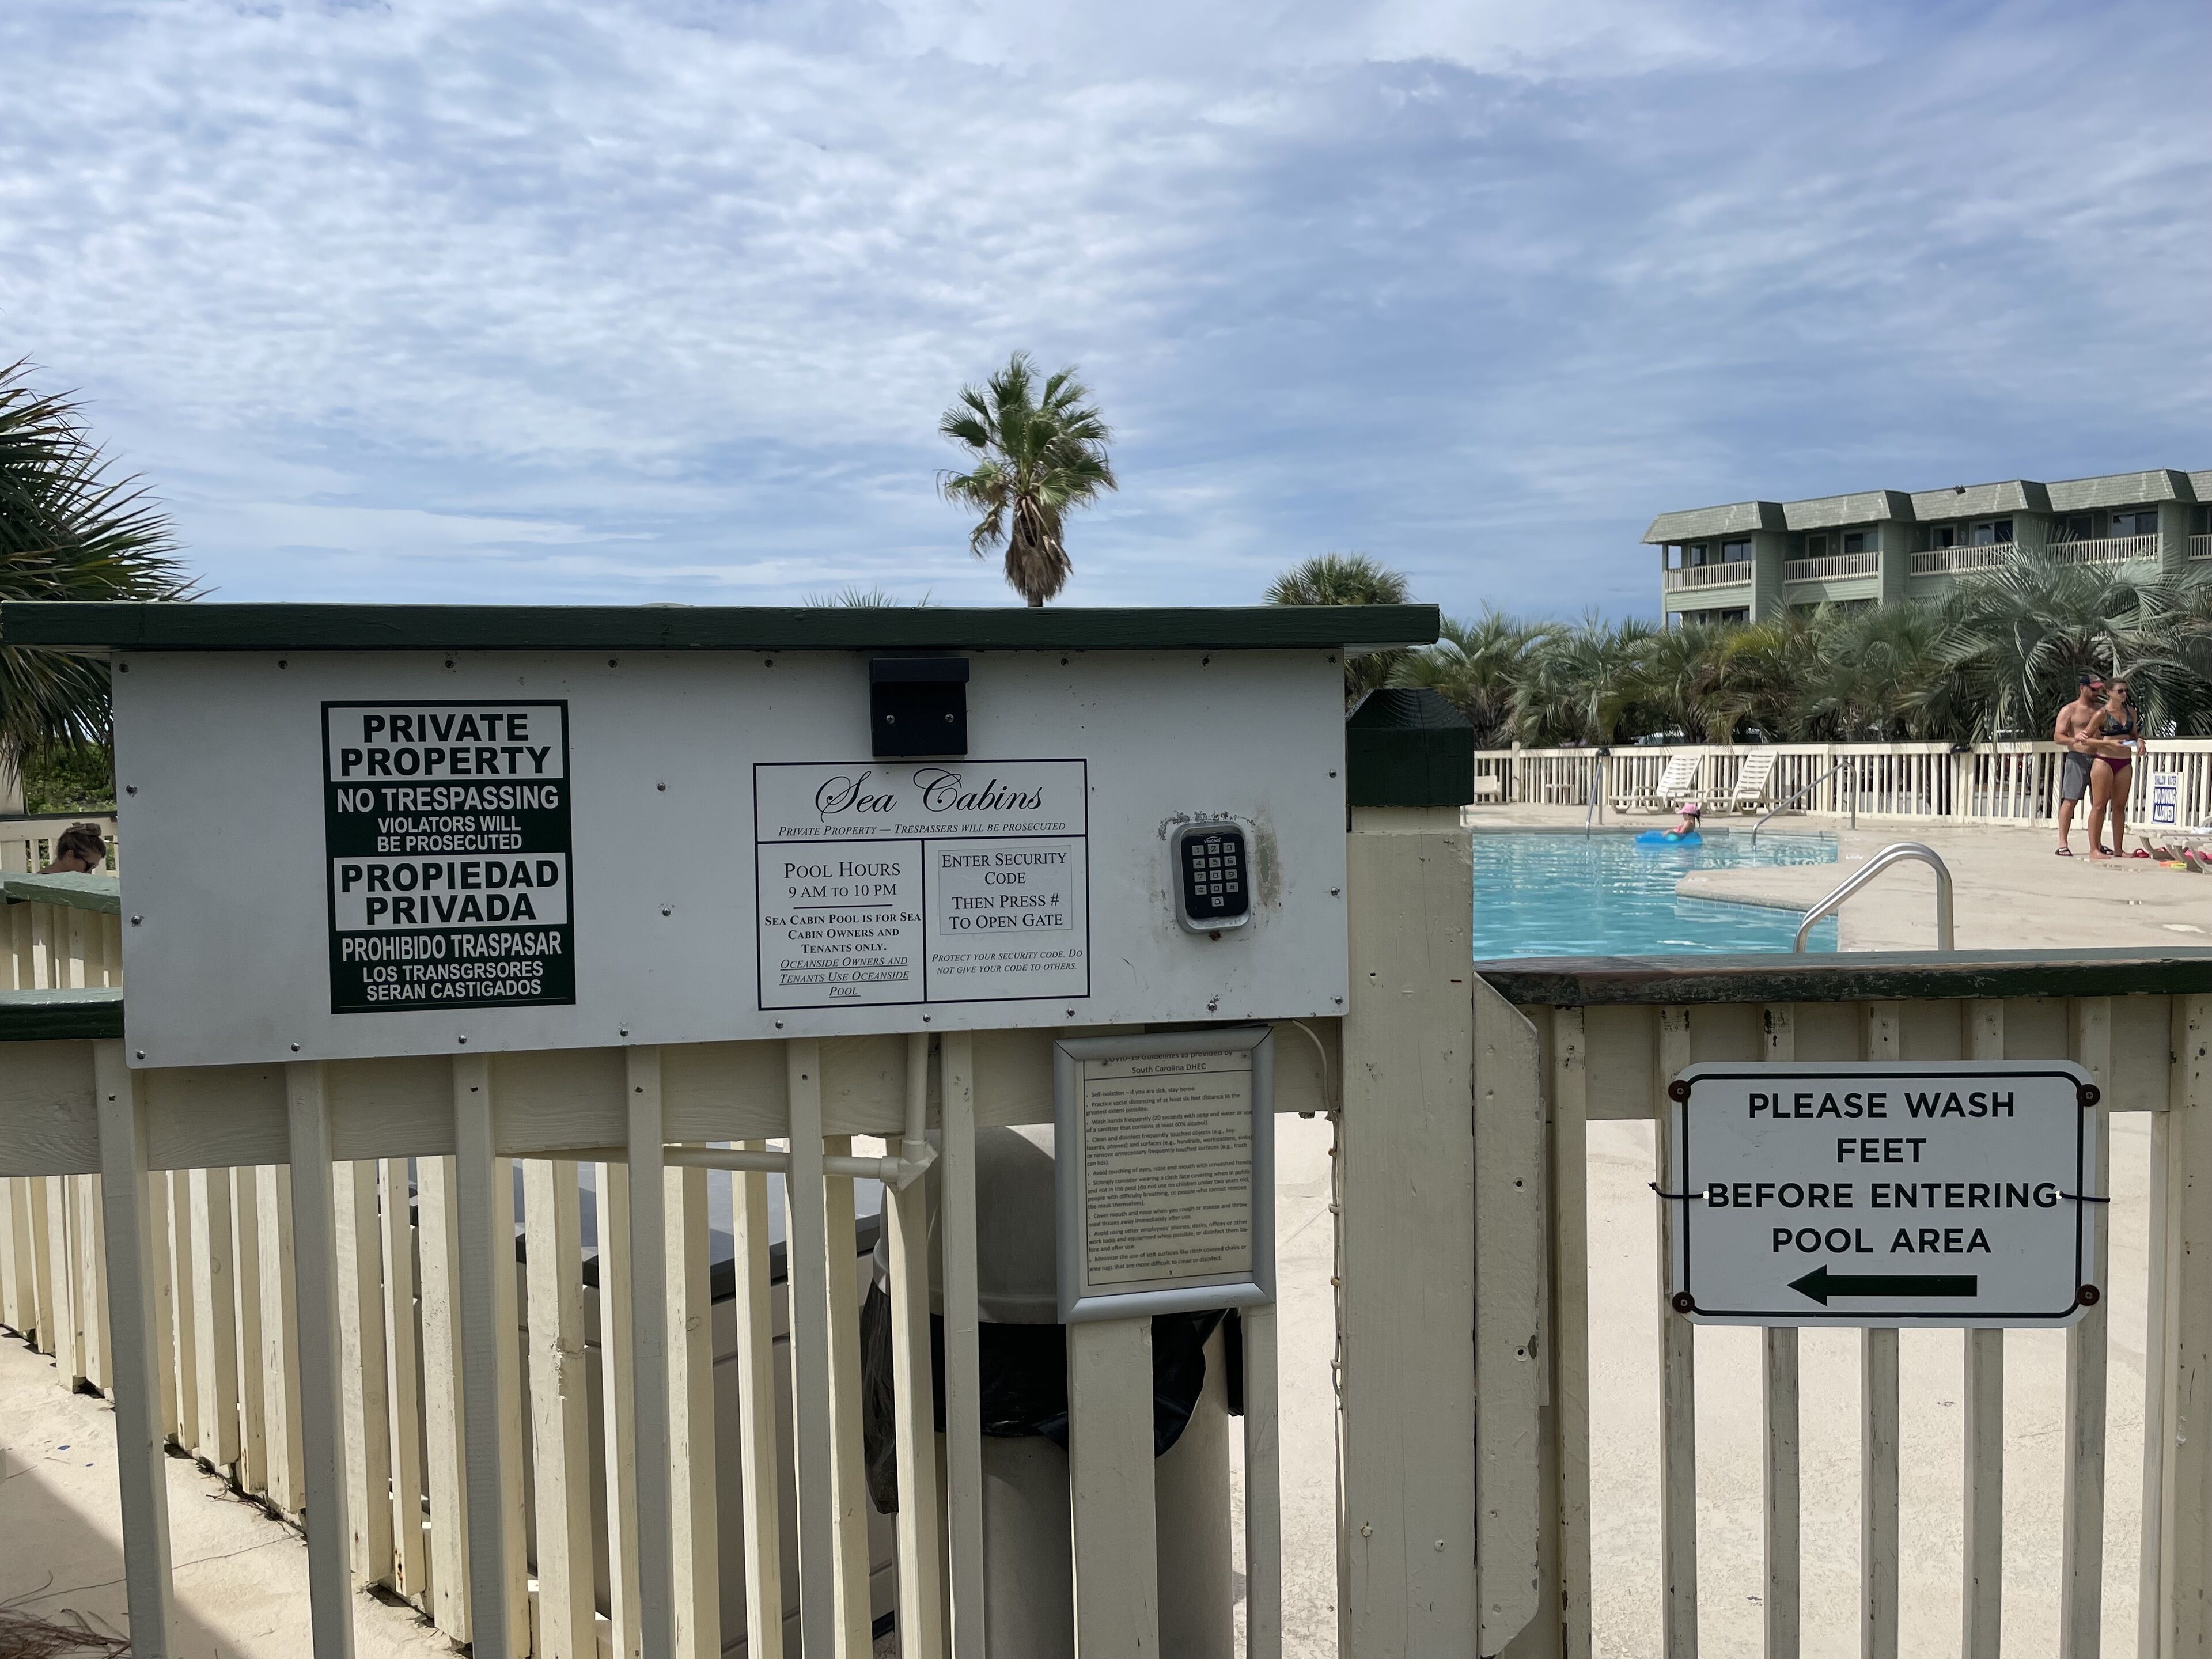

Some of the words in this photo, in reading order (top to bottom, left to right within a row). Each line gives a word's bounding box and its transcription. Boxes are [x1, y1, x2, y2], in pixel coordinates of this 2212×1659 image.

[363, 714, 528, 743] PRIVATE
[341, 747, 551, 776] PROPERTY
[338, 789, 374, 812] NO
[381, 786, 558, 811] TRESPASSING
[815, 771, 897, 823] Sea
[913, 768, 1042, 812] Cabins
[2154, 788, 2160, 804] NO
[2161, 789, 2176, 804] DIVING
[2154, 805, 2174, 821] ALLOWED
[378, 816, 475, 833] VIOLATORS
[480, 816, 521, 831] WILL
[378, 836, 400, 851] BE
[406, 834, 522, 851] PROSECUTED
[942, 855, 991, 867] ENTER
[996, 853, 1067, 866] SECURITY
[342, 861, 558, 892] PROPIEDAD
[785, 863, 832, 878] POOL
[839, 862, 900, 877] HOURS
[985, 872, 1025, 884] CODE
[789, 887, 796, 898] 9
[801, 886, 826, 897] AM
[832, 888, 848, 896] TO
[855, 885, 869, 896] 10
[874, 884, 896, 896] PM
[366, 893, 536, 925] PRIVADA
[952, 897, 994, 909] THEN
[999, 895, 1045, 908] PRESS
[1051, 893, 1059, 906] #
[765, 916, 786, 925] SEA
[790, 916, 824, 925] CABIN
[830, 915, 859, 923] POOL
[900, 912, 921, 921] SEA
[949, 916, 970, 929] TO
[976, 915, 1017, 928] OPEN
[1022, 914, 1063, 926] GATE
[788, 930, 823, 939] CABIN
[827, 929, 873, 938] OWNERS
[343, 935, 445, 961] PROHIBIDO
[451, 931, 562, 957] TRASPASAR
[801, 944, 851, 953] TENANTS
[780, 959, 838, 969] OCEANSIDE
[842, 957, 884, 967] OWNERS
[888, 956, 908, 965] AND
[363, 966, 397, 982] LOS
[403, 961, 543, 980] TRANSGRSORES
[779, 973, 824, 984] TENANTS
[828, 972, 849, 982] USE
[852, 971, 909, 981] OCEANSIDE
[367, 984, 425, 1001] SERAN
[431, 979, 541, 998] CASTIGADOS
[829, 987, 858, 997] POOL
[1131, 1066, 1153, 1074] South
[1154, 1064, 1184, 1073] Carolina
[1186, 1063, 1206, 1071] DHEC
[1750, 1093, 1887, 1118] PLEASE
[1904, 1092, 2013, 1118] WASH
[1838, 1138, 1926, 1162] FEET
[1708, 1183, 1853, 1208] BEFORE
[1872, 1183, 2058, 1208] ENTERING
[1773, 1228, 1873, 1253] POOL
[1890, 1228, 1991, 1253] AREA
